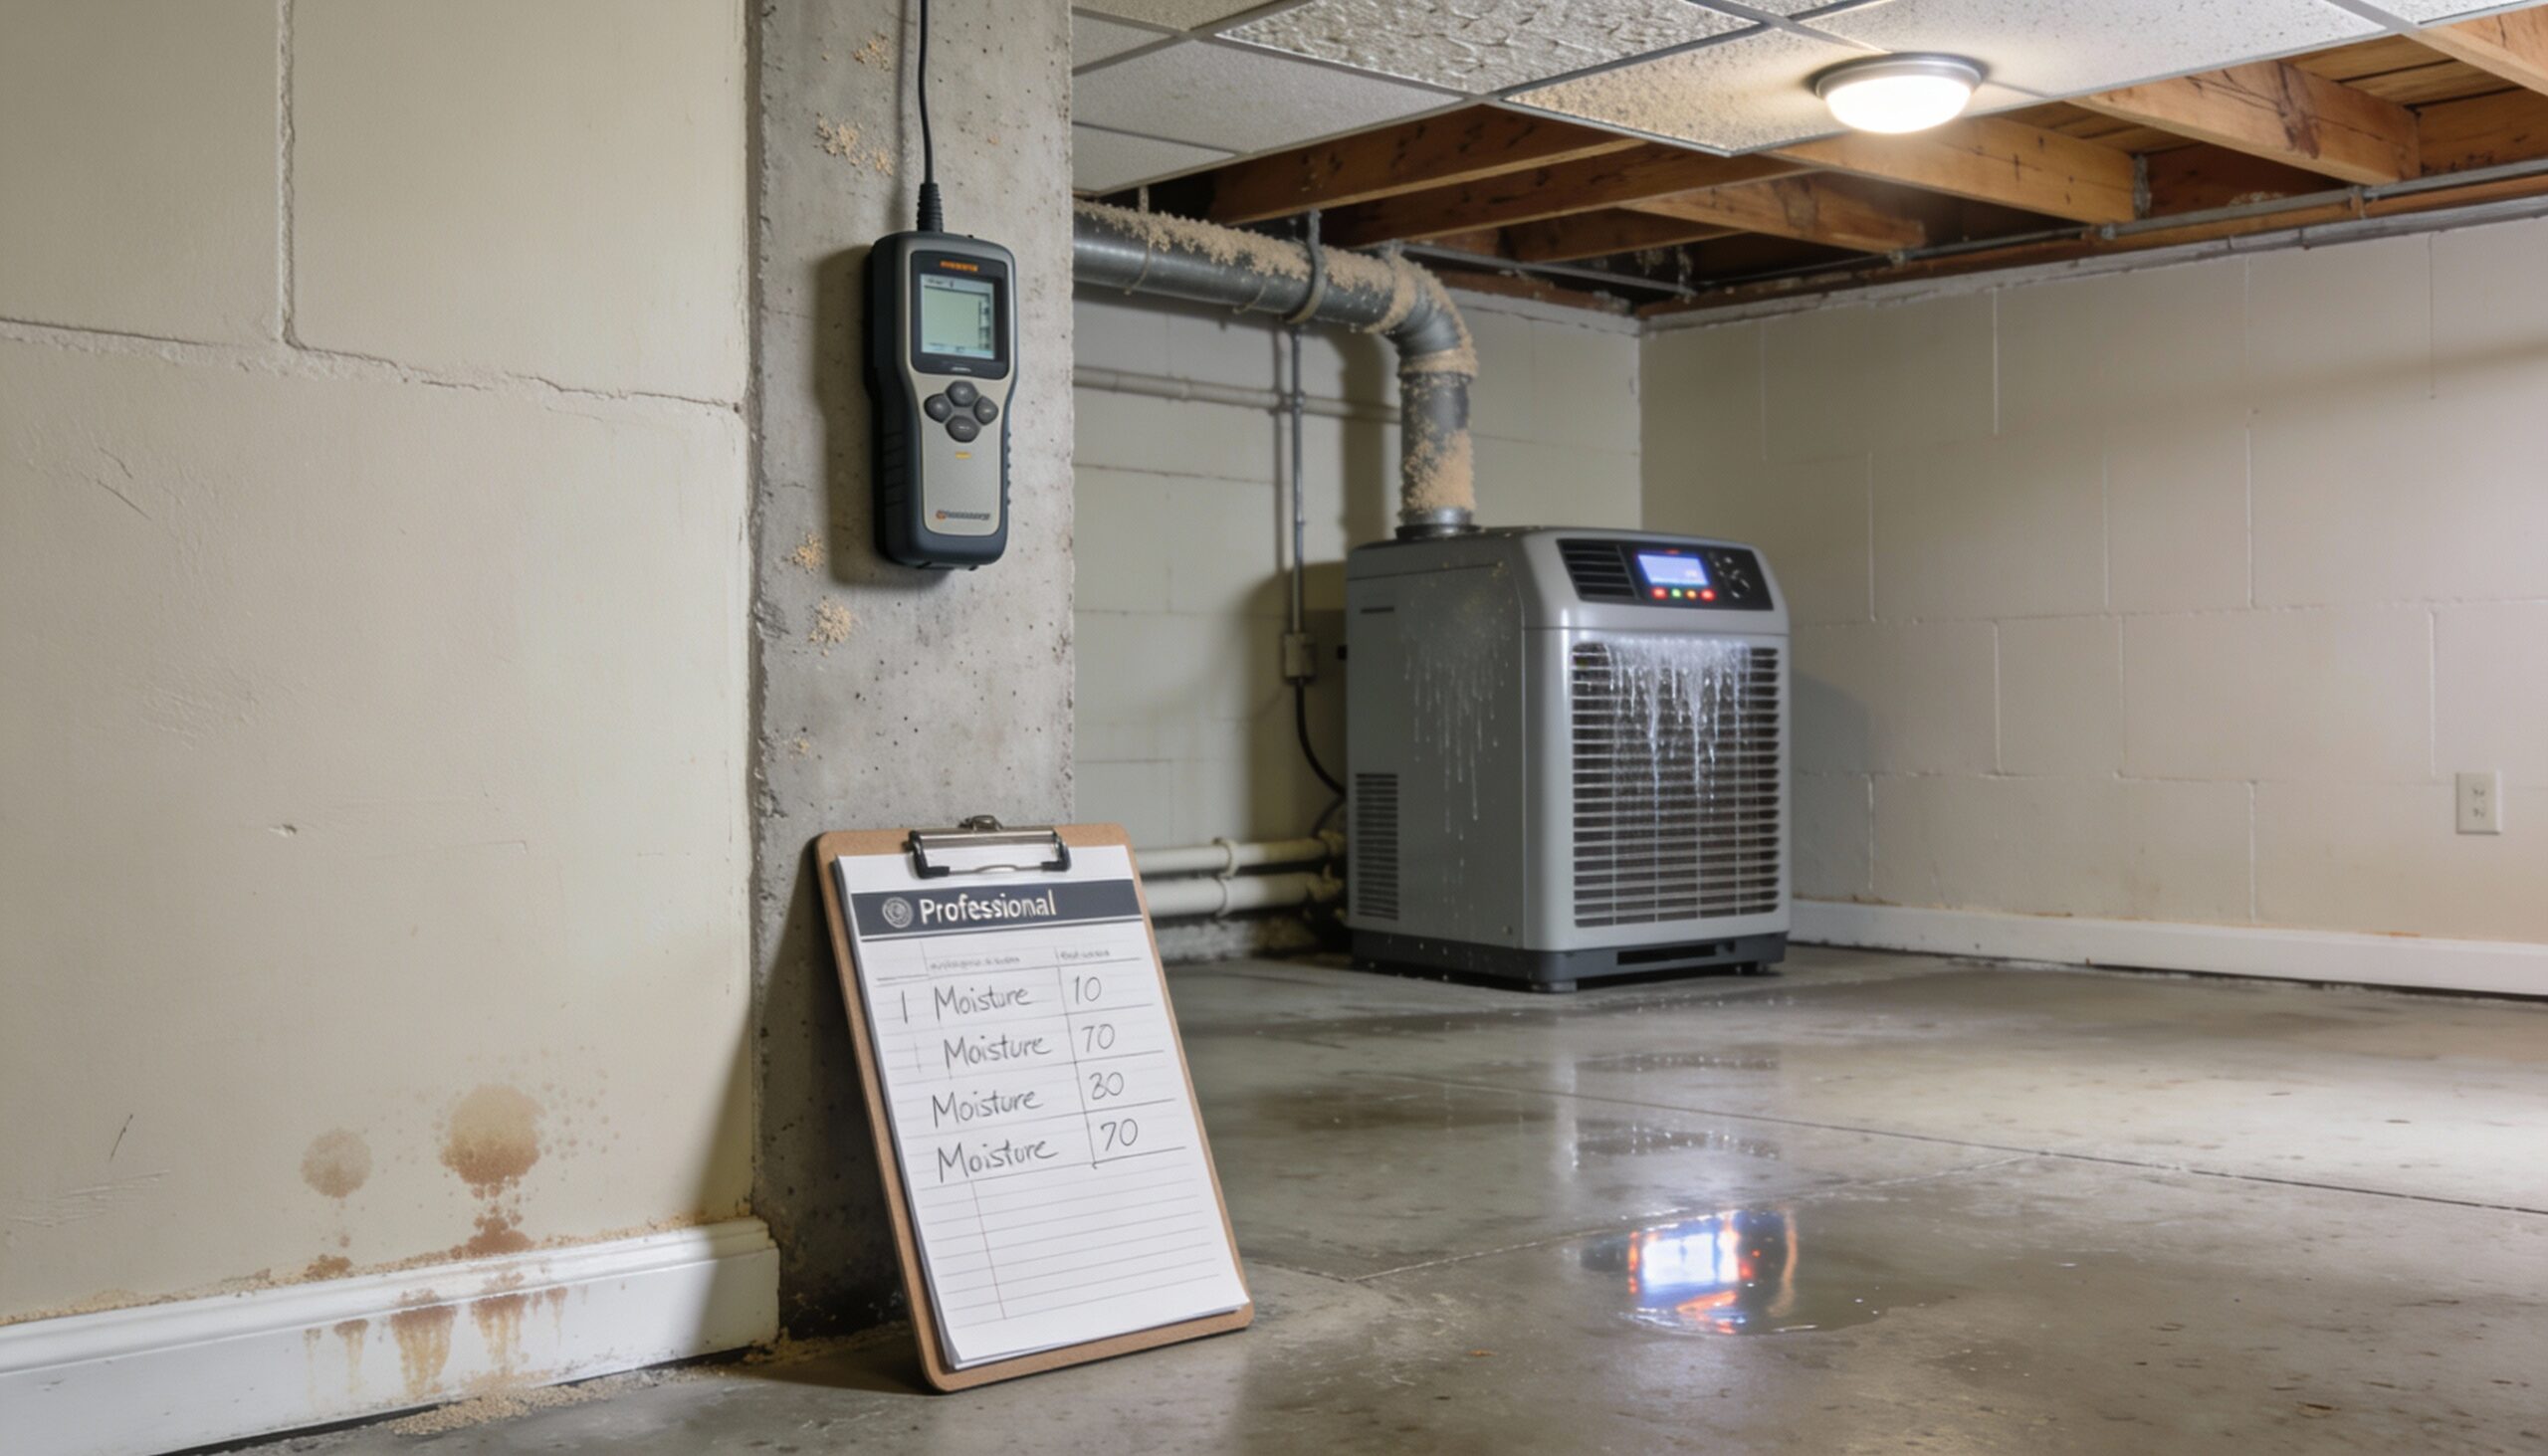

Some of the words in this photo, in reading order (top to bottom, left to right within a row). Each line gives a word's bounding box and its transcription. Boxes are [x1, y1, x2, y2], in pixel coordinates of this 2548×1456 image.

[919, 890, 1056, 924] Professional
[934, 985, 1031, 1021] Moisture
[1073, 975, 1102, 1004] 10
[944, 1035, 1053, 1071] Moisture
[1081, 1022, 1116, 1054] 70
[932, 1091, 1044, 1130] Moisture
[937, 1140, 1060, 1184] Moisture
[1100, 1118, 1140, 1152] 70
